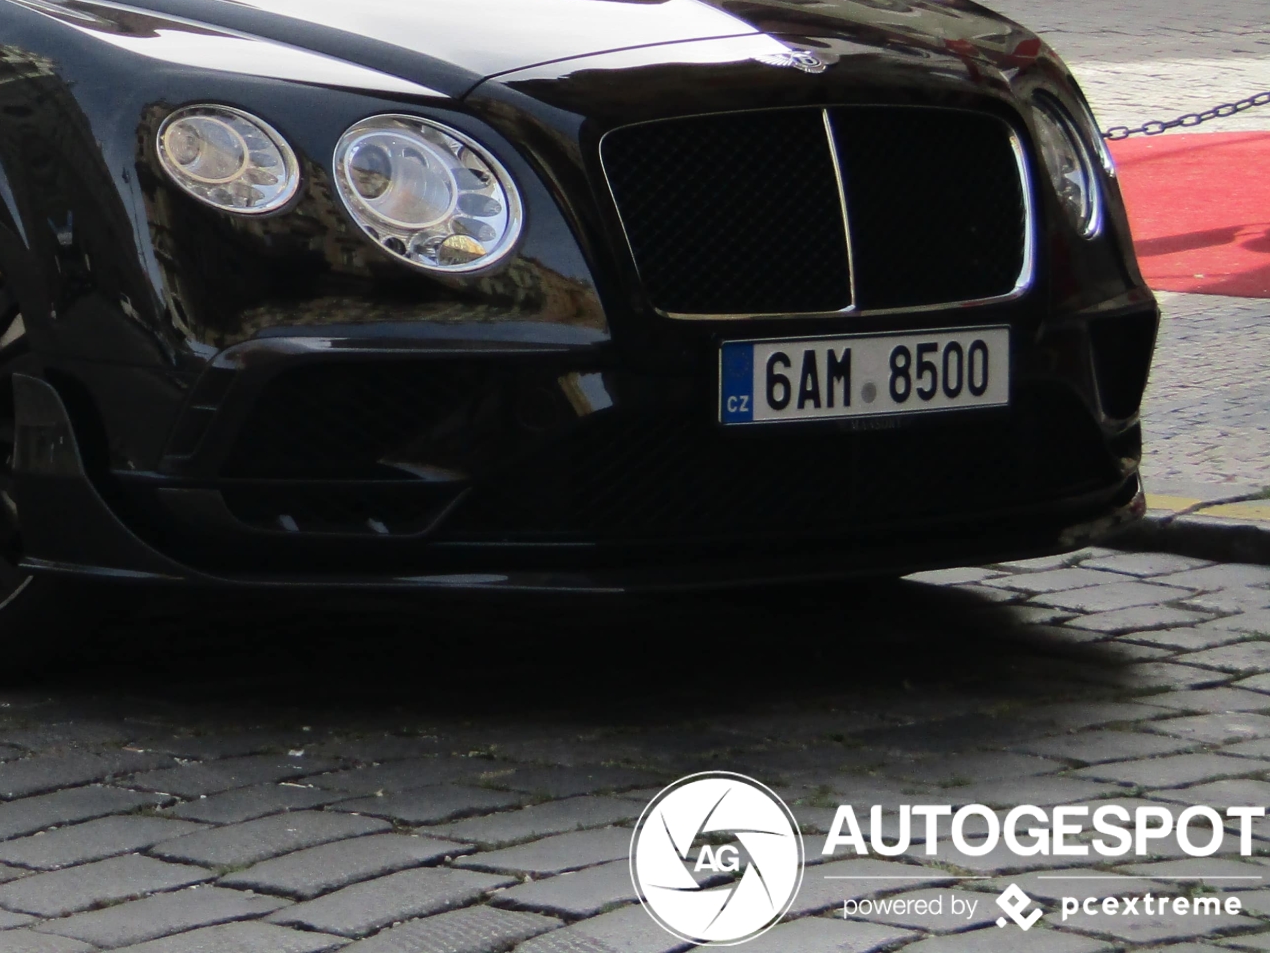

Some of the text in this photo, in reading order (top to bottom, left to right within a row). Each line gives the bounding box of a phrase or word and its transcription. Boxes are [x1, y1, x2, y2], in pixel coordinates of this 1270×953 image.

[766, 339, 989, 411] 6AM 8500
[727, 395, 749, 413] CZ
